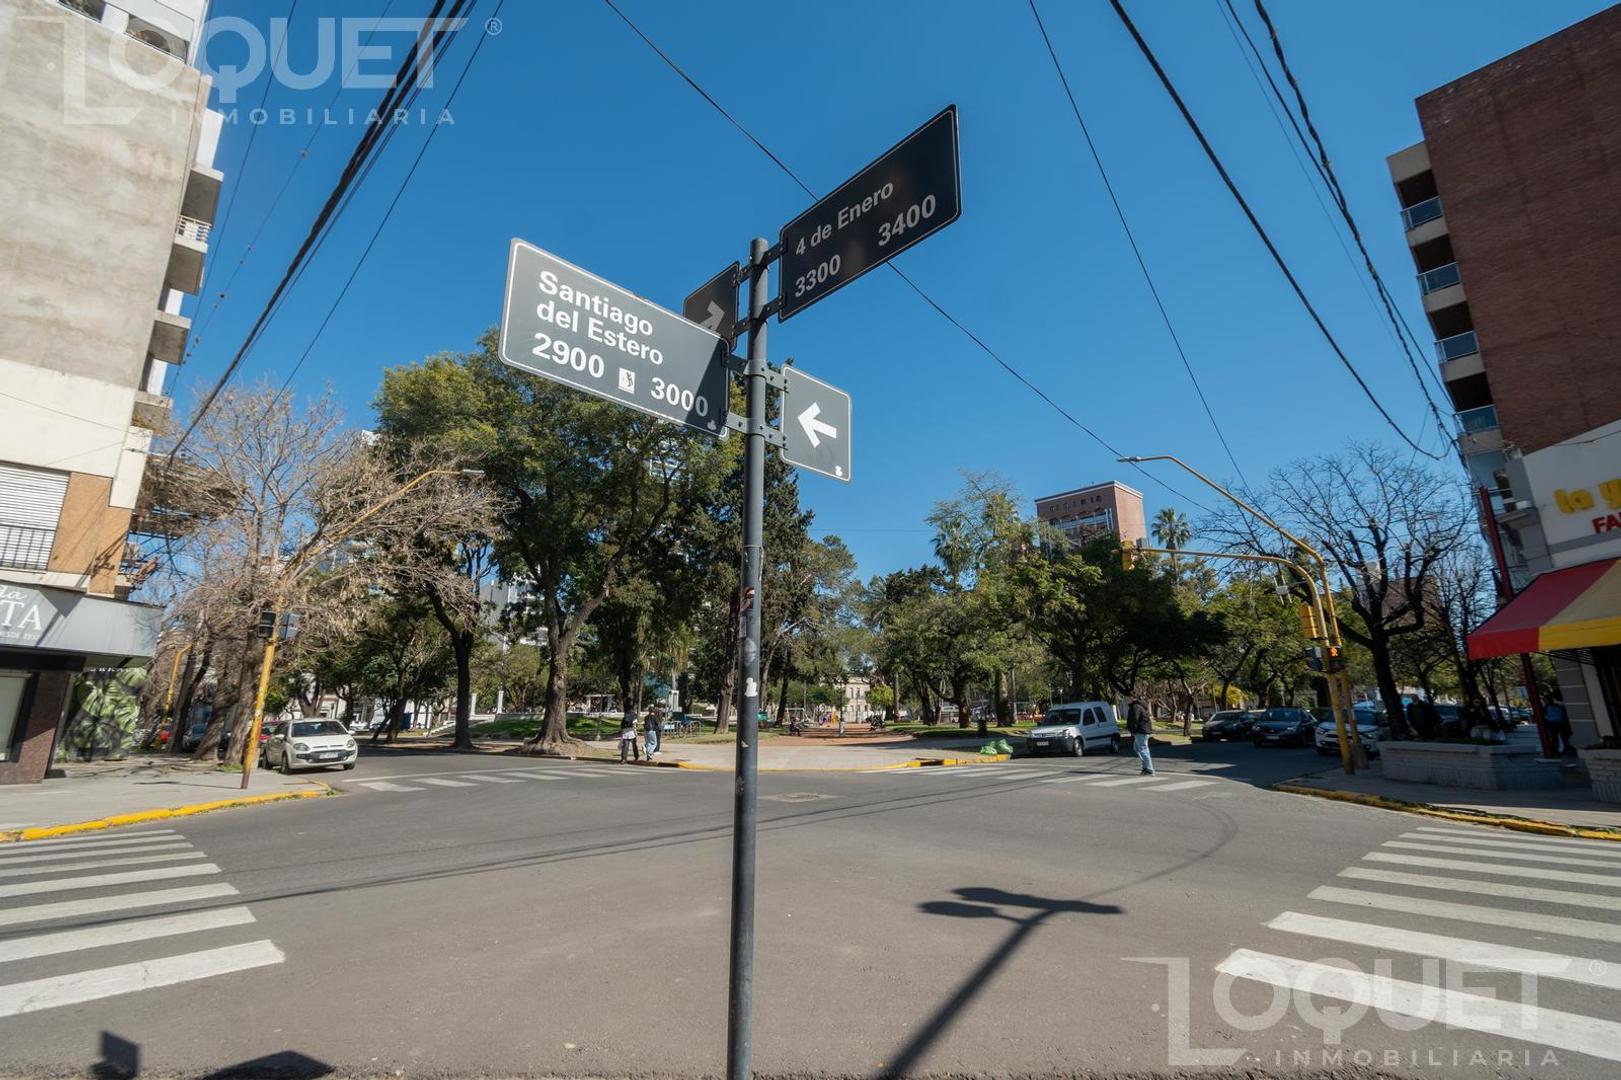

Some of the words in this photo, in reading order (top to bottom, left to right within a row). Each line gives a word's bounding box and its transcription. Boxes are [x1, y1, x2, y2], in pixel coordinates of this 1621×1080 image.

[794, 254, 841, 298] 3300
[877, 194, 936, 247] 3400
[795, 234, 807, 256] 4
[810, 223, 832, 247] de
[837, 182, 894, 230] Enero
[536, 300, 579, 333] del
[587, 316, 664, 366] Estero
[538, 270, 653, 336] Santiago
[531, 332, 605, 379] 2900
[650, 376, 709, 418] 3000
